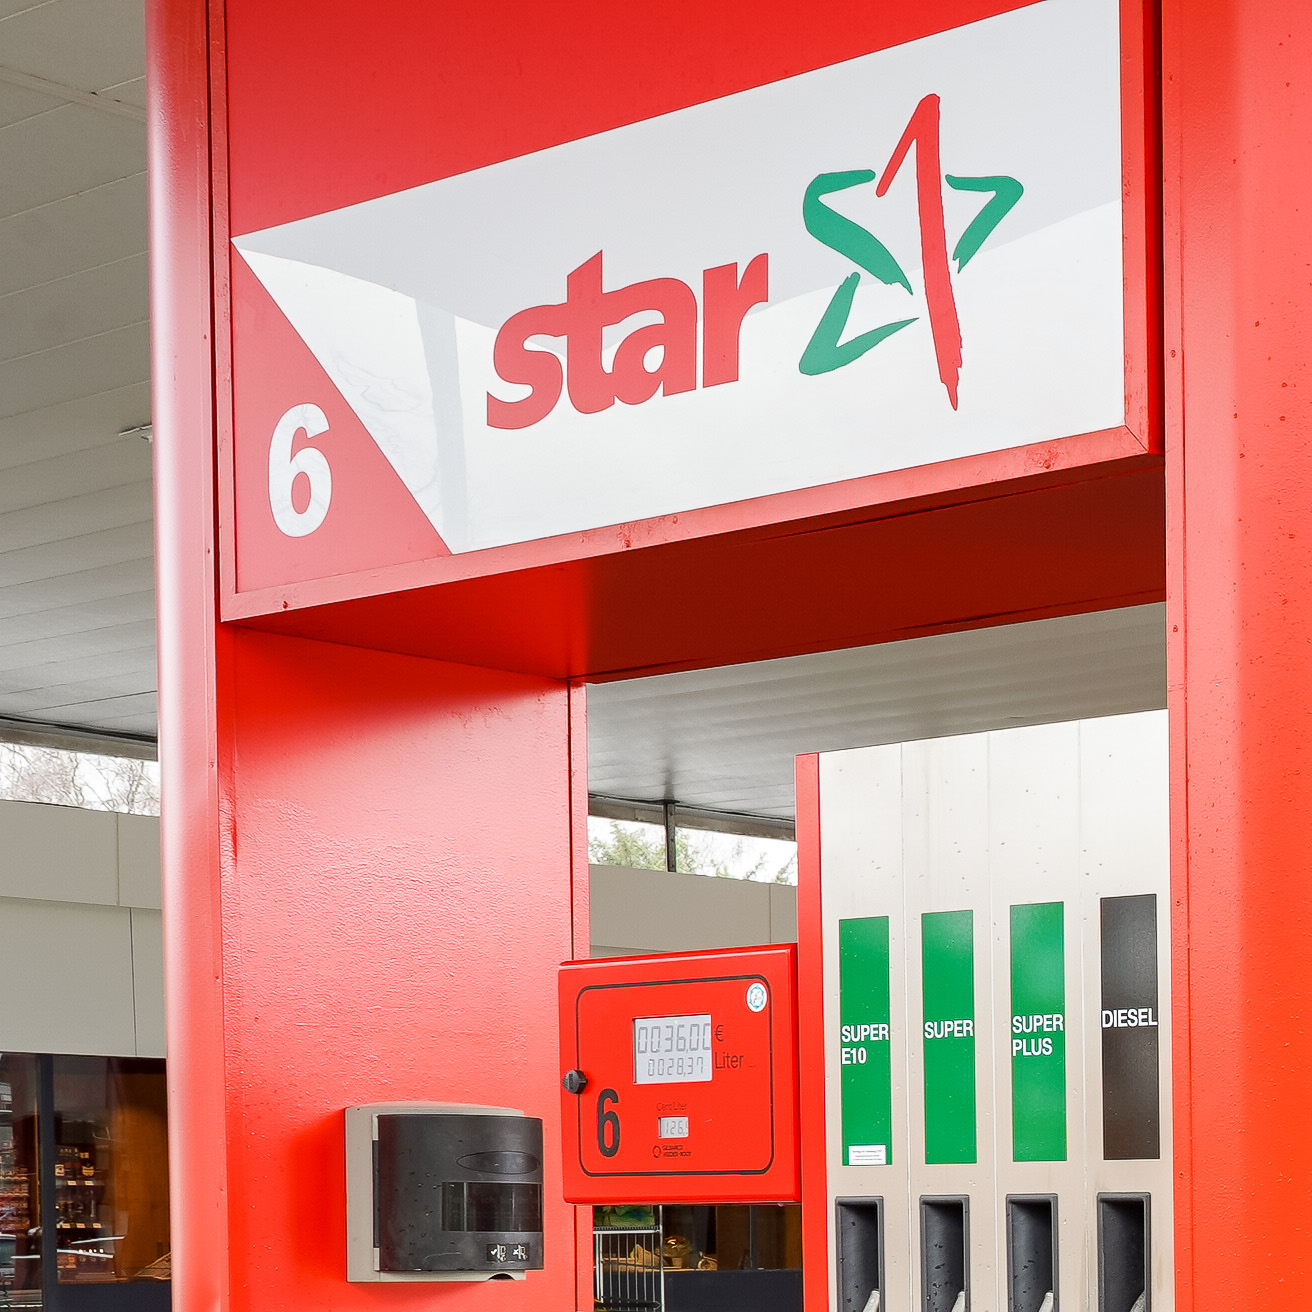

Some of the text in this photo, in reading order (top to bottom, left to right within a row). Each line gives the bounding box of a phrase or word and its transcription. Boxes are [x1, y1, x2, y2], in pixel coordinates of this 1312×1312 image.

[486, 249, 768, 430] star
[268, 402, 332, 538] 6
[1012, 1013, 1064, 1034] SUPER
[1101, 1007, 1158, 1029] DIESEL
[841, 1023, 889, 1043] SUPER
[924, 1019, 974, 1039] SUPER
[841, 1047, 867, 1065] E10
[1012, 1037, 1053, 1057] PLUS
[714, 1052, 744, 1069] Liter
[597, 1088, 621, 1158] 6
